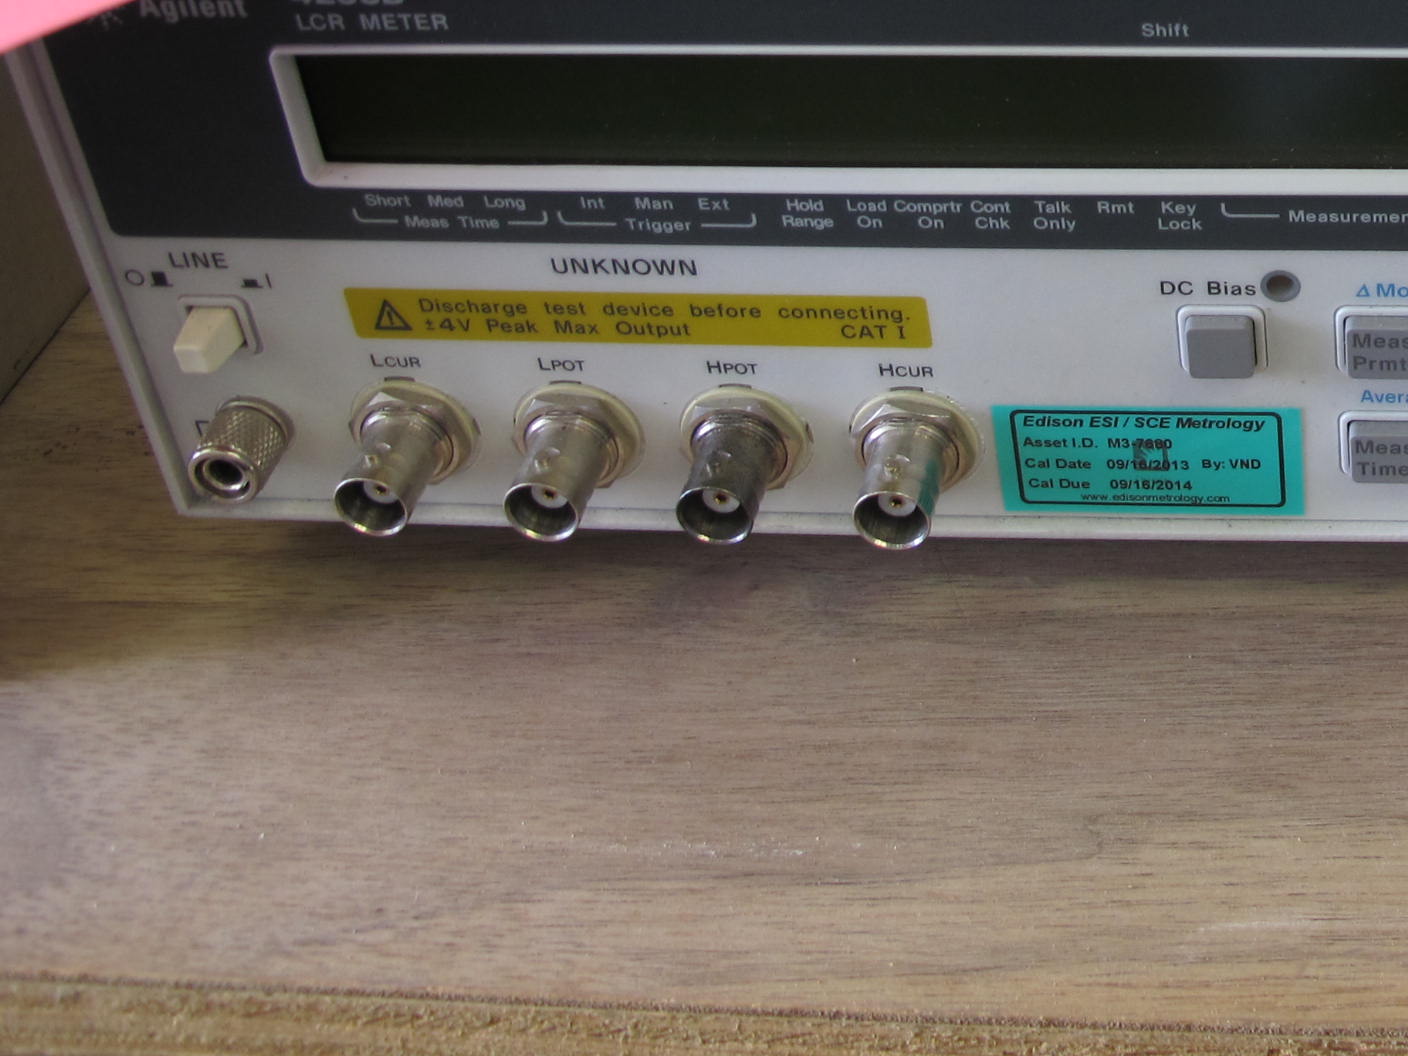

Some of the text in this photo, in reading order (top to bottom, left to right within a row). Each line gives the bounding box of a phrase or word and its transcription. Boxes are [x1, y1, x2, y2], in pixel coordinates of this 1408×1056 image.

[296, 13, 449, 31] LCR METER
[1141, 22, 1190, 38] Shift
[364, 193, 527, 212] Short Med Long
[580, 196, 730, 212] Int Man Ext
[786, 198, 824, 213] Hold
[846, 199, 887, 213] Load
[894, 199, 962, 215] Comprtr
[970, 200, 1011, 214] Cont
[1033, 200, 1072, 215] Talk
[1097, 201, 1135, 215] Rmt
[1160, 201, 1197, 216] Key
[404, 215, 500, 230] Meas Time
[625, 216, 692, 234] Trigger
[782, 214, 835, 230] Range
[856, 215, 883, 230] On
[917, 215, 945, 230] On
[974, 216, 1011, 230] Chk
[1032, 216, 1077, 232] Only
[1157, 216, 1202, 231] Lock
[168, 251, 230, 269] LINE
[549, 256, 698, 277] UNKNOWN
[1159, 281, 1257, 296] DC Bias
[417, 297, 911, 324] Discharge test device before connecting.
[486, 319, 539, 335] Peak
[553, 320, 600, 335] Max
[615, 321, 692, 338] Output
[840, 325, 888, 340] CAT
[1022, 415, 1084, 428] Edison
[1089, 416, 1119, 428] ESI
[1134, 416, 1171, 429] SCE
[1175, 416, 1266, 431] Metrology
[1022, 437, 1069, 449] Asset
[1025, 458, 1051, 470] Cal
[1055, 458, 1092, 470] Date
[1201, 459, 1226, 472] By:
[1230, 459, 1262, 470] VND
[1028, 478, 1054, 489] Cal
[1059, 478, 1091, 490] Due
[1081, 493, 1230, 504] www.edisonmetrology.com
